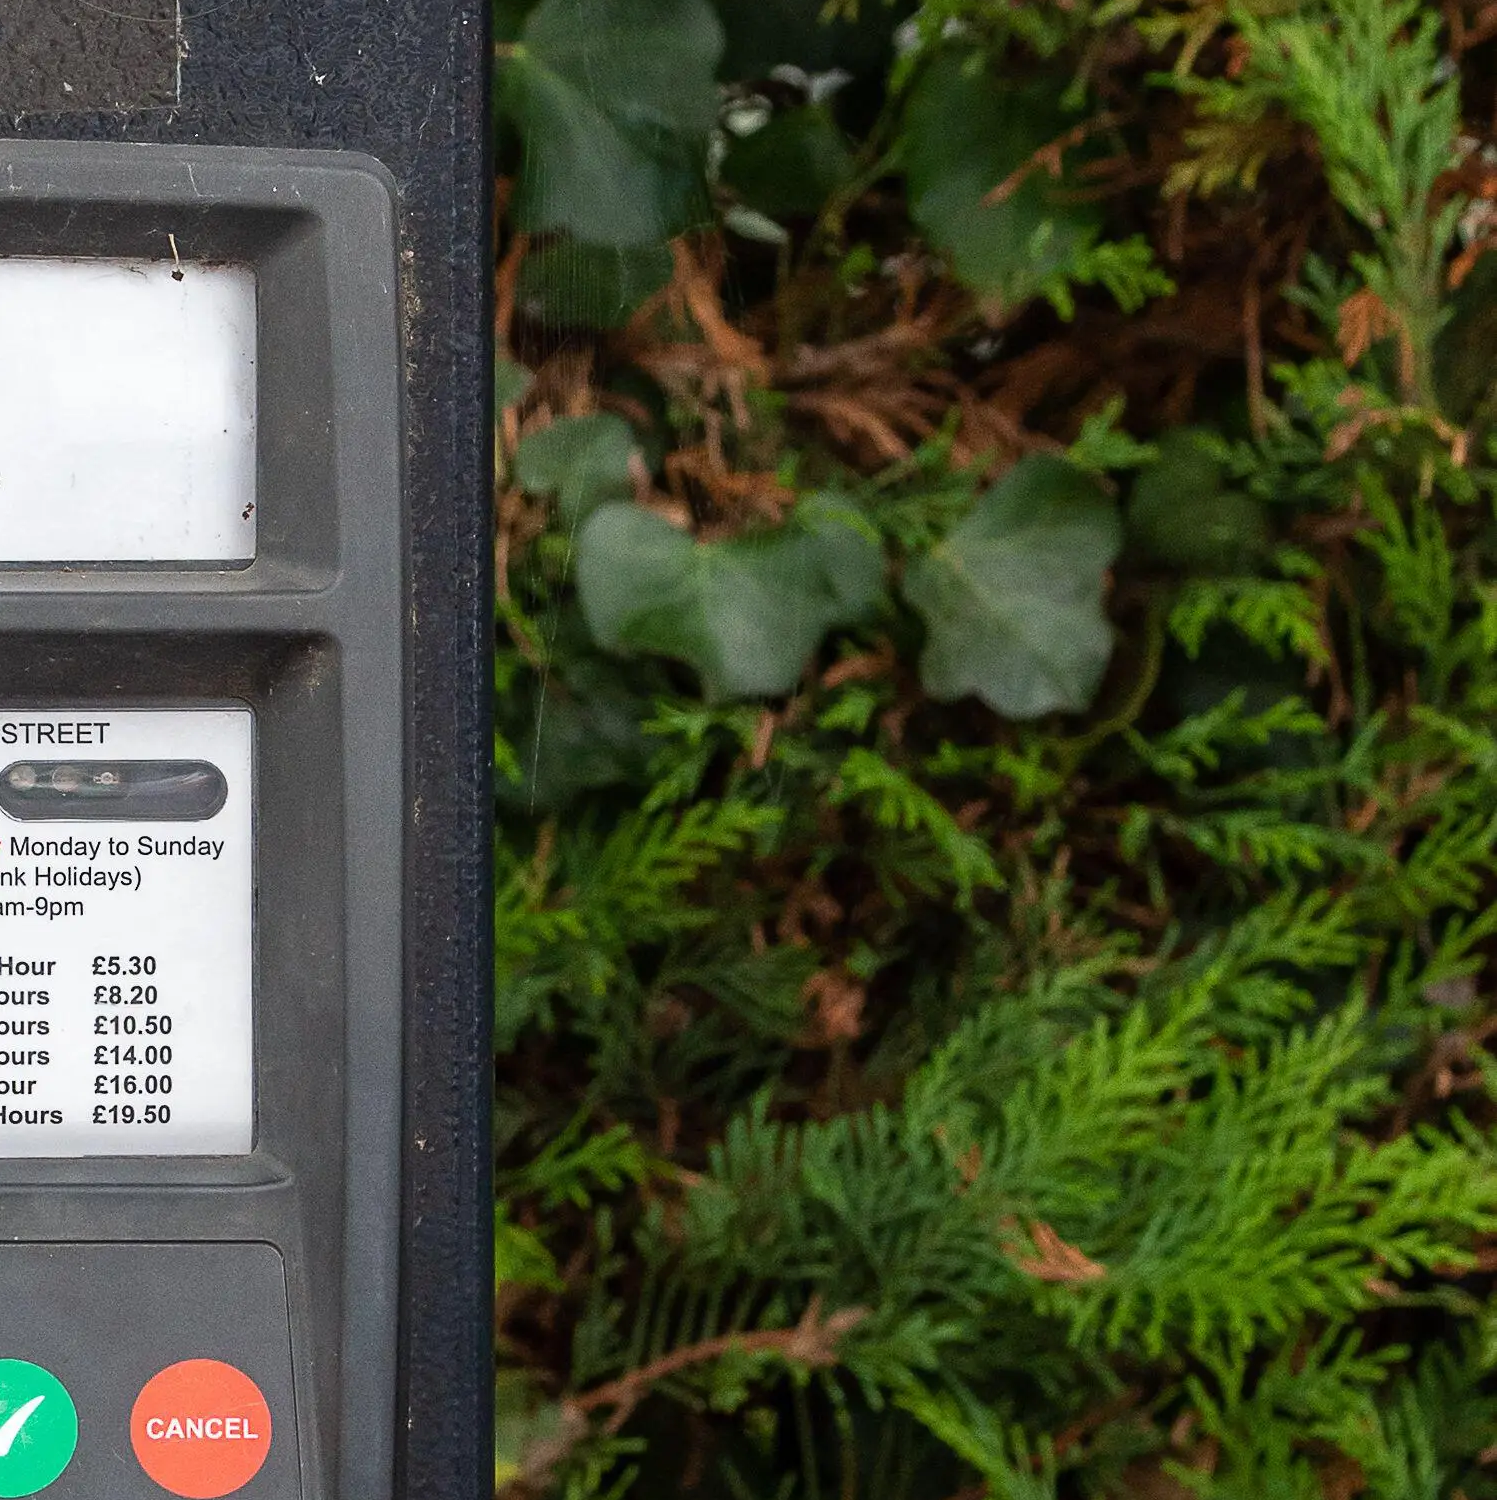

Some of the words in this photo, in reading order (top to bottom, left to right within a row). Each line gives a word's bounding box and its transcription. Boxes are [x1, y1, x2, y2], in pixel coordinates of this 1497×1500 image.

[1, 722, 111, 745] STREET
[10, 836, 102, 861] Monday
[108, 837, 130, 856] to
[137, 835, 225, 861] Sunday
[35, 865, 142, 891] Holidays)
[91, 955, 157, 976] £5.30
[93, 985, 158, 1005] £8.20
[93, 1015, 172, 1036] £10.50
[93, 1045, 173, 1065] £14.00
[93, 1074, 173, 1095] £16.00
[92, 1104, 171, 1125] £19.50
[146, 1417, 259, 1440] CANCEL
